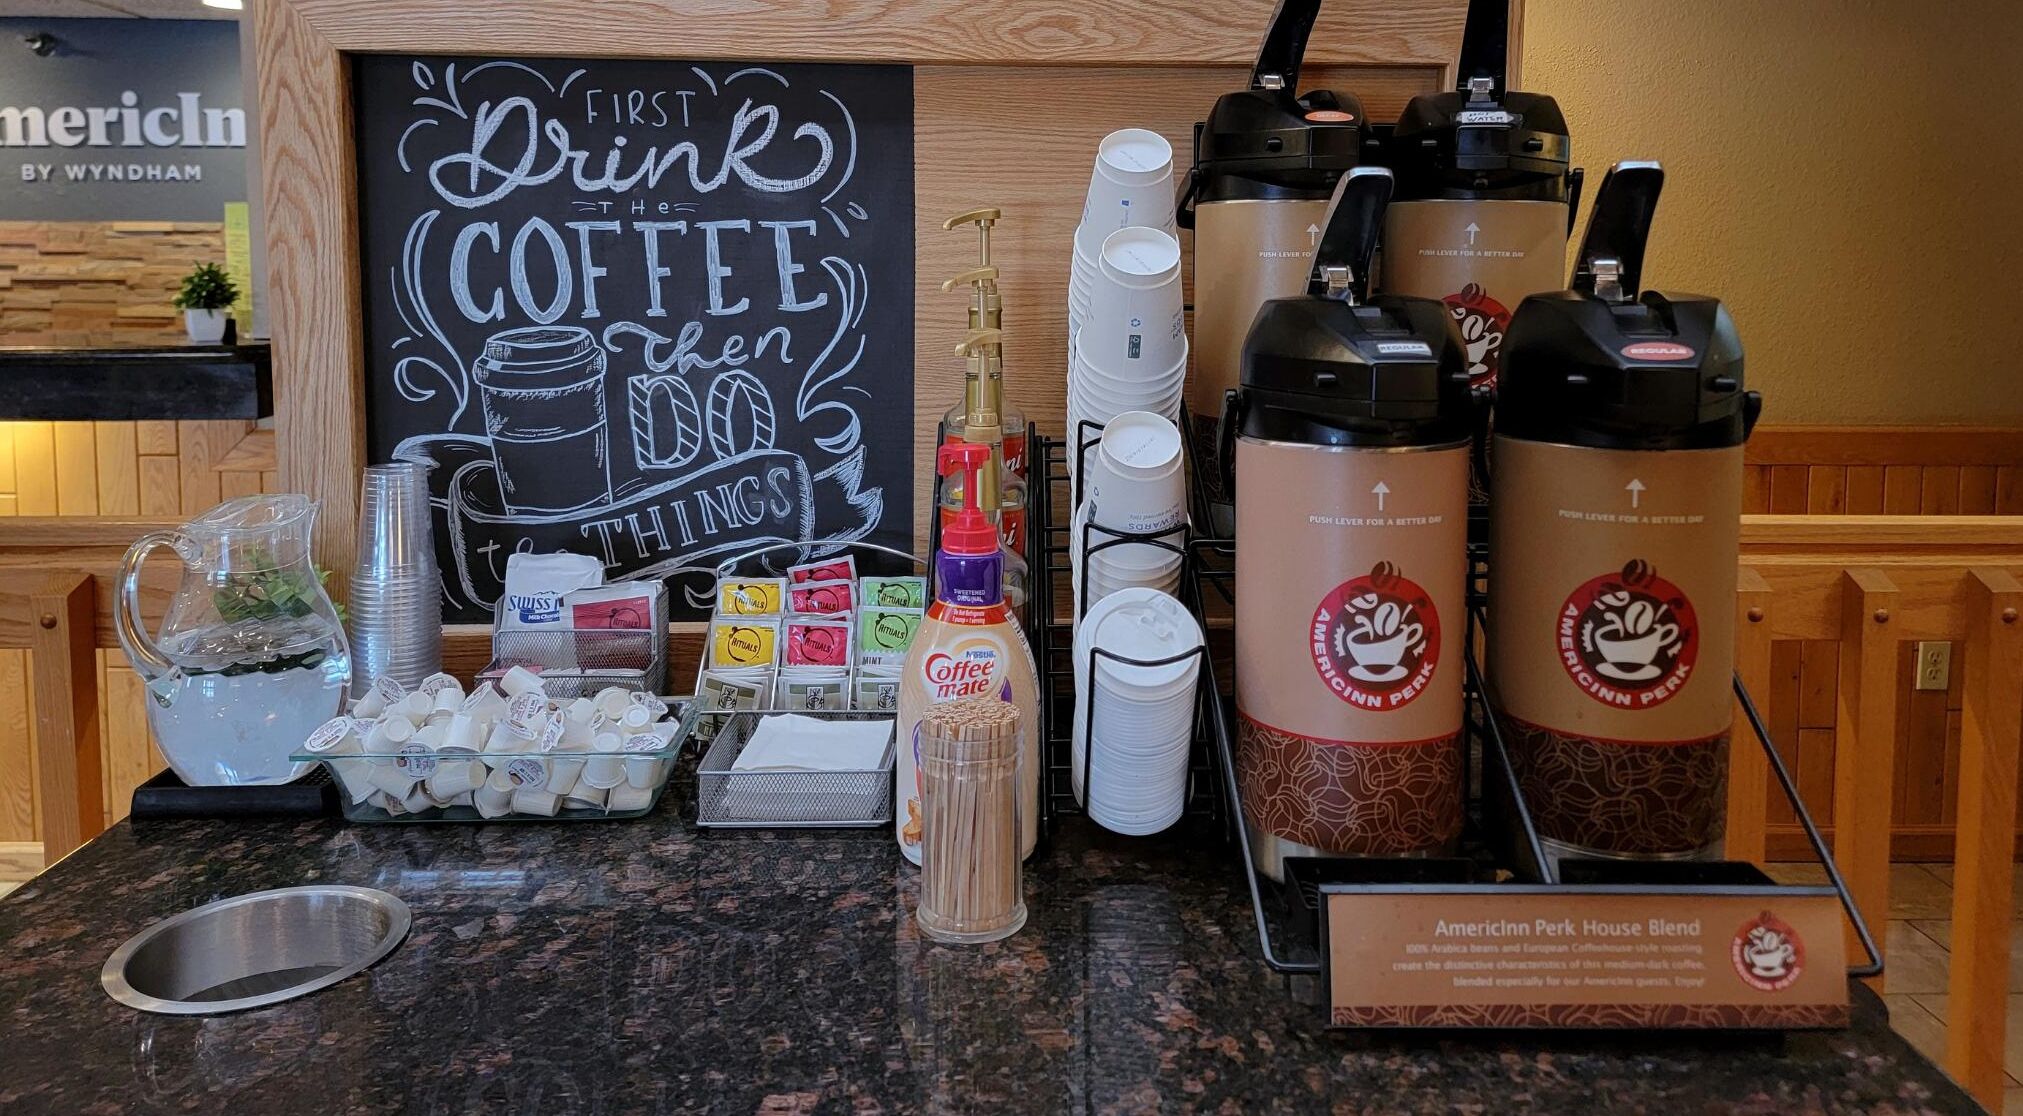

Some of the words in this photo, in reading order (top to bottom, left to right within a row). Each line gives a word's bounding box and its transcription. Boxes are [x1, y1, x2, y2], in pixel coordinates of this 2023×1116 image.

[586, 89, 696, 127] FIRST
[0, 90, 247, 147] mericIn
[21, 164, 52, 181] BY
[65, 164, 202, 181] WYNDHAM
[450, 215, 828, 325] COFFEE
[627, 369, 776, 470] DO
[581, 466, 793, 568] THINGS
[1309, 515, 1332, 524] PUSH
[1335, 517, 1362, 526] LEVER
[1366, 518, 1385, 526] FOR
[1387, 518, 1394, 526] A
[1396, 517, 1427, 526] BETTER
[1559, 509, 1583, 519] PUSH
[1585, 513, 1616, 522] LEVER
[1618, 514, 1640, 523] FOR
[1642, 516, 1649, 524] A
[1652, 515, 1686, 524] BETTER
[508, 595, 551, 611] SWISS
[881, 593, 908, 606] RITUALS
[878, 624, 905, 640] RITUALS
[731, 637, 759, 653] RITUALS
[804, 637, 832, 654] RITUALS
[862, 656, 882, 665] MINT
[1313, 607, 1382, 708] AMERICINN
[1390, 661, 1434, 706] PERK
[1560, 603, 1632, 706] AMERICINN
[1640, 662, 1691, 705] PERK
[925, 652, 994, 684] Coffee
[937, 678, 989, 698] mate
[1434, 918, 1530, 937] AmericInn
[1535, 918, 1577, 937] Perk
[1583, 918, 1642, 937] House
[1648, 918, 1701, 937] Blend
[1431, 943, 1468, 953] Arabica
[1469, 943, 1499, 953] beans
[1502, 942, 1521, 953] and
[1523, 942, 1569, 955] European
[1393, 961, 1422, 971] create
[1425, 960, 1441, 970] the
[1443, 960, 1494, 970] distinctive
[1496, 960, 1567, 970] characteristics
[1568, 959, 1581, 969] of
[1582, 960, 1601, 969] this
[1453, 976, 1493, 987] blended
[1496, 976, 1544, 988] especially
[1546, 976, 1560, 986] for
[1563, 977, 1580, 986] our
